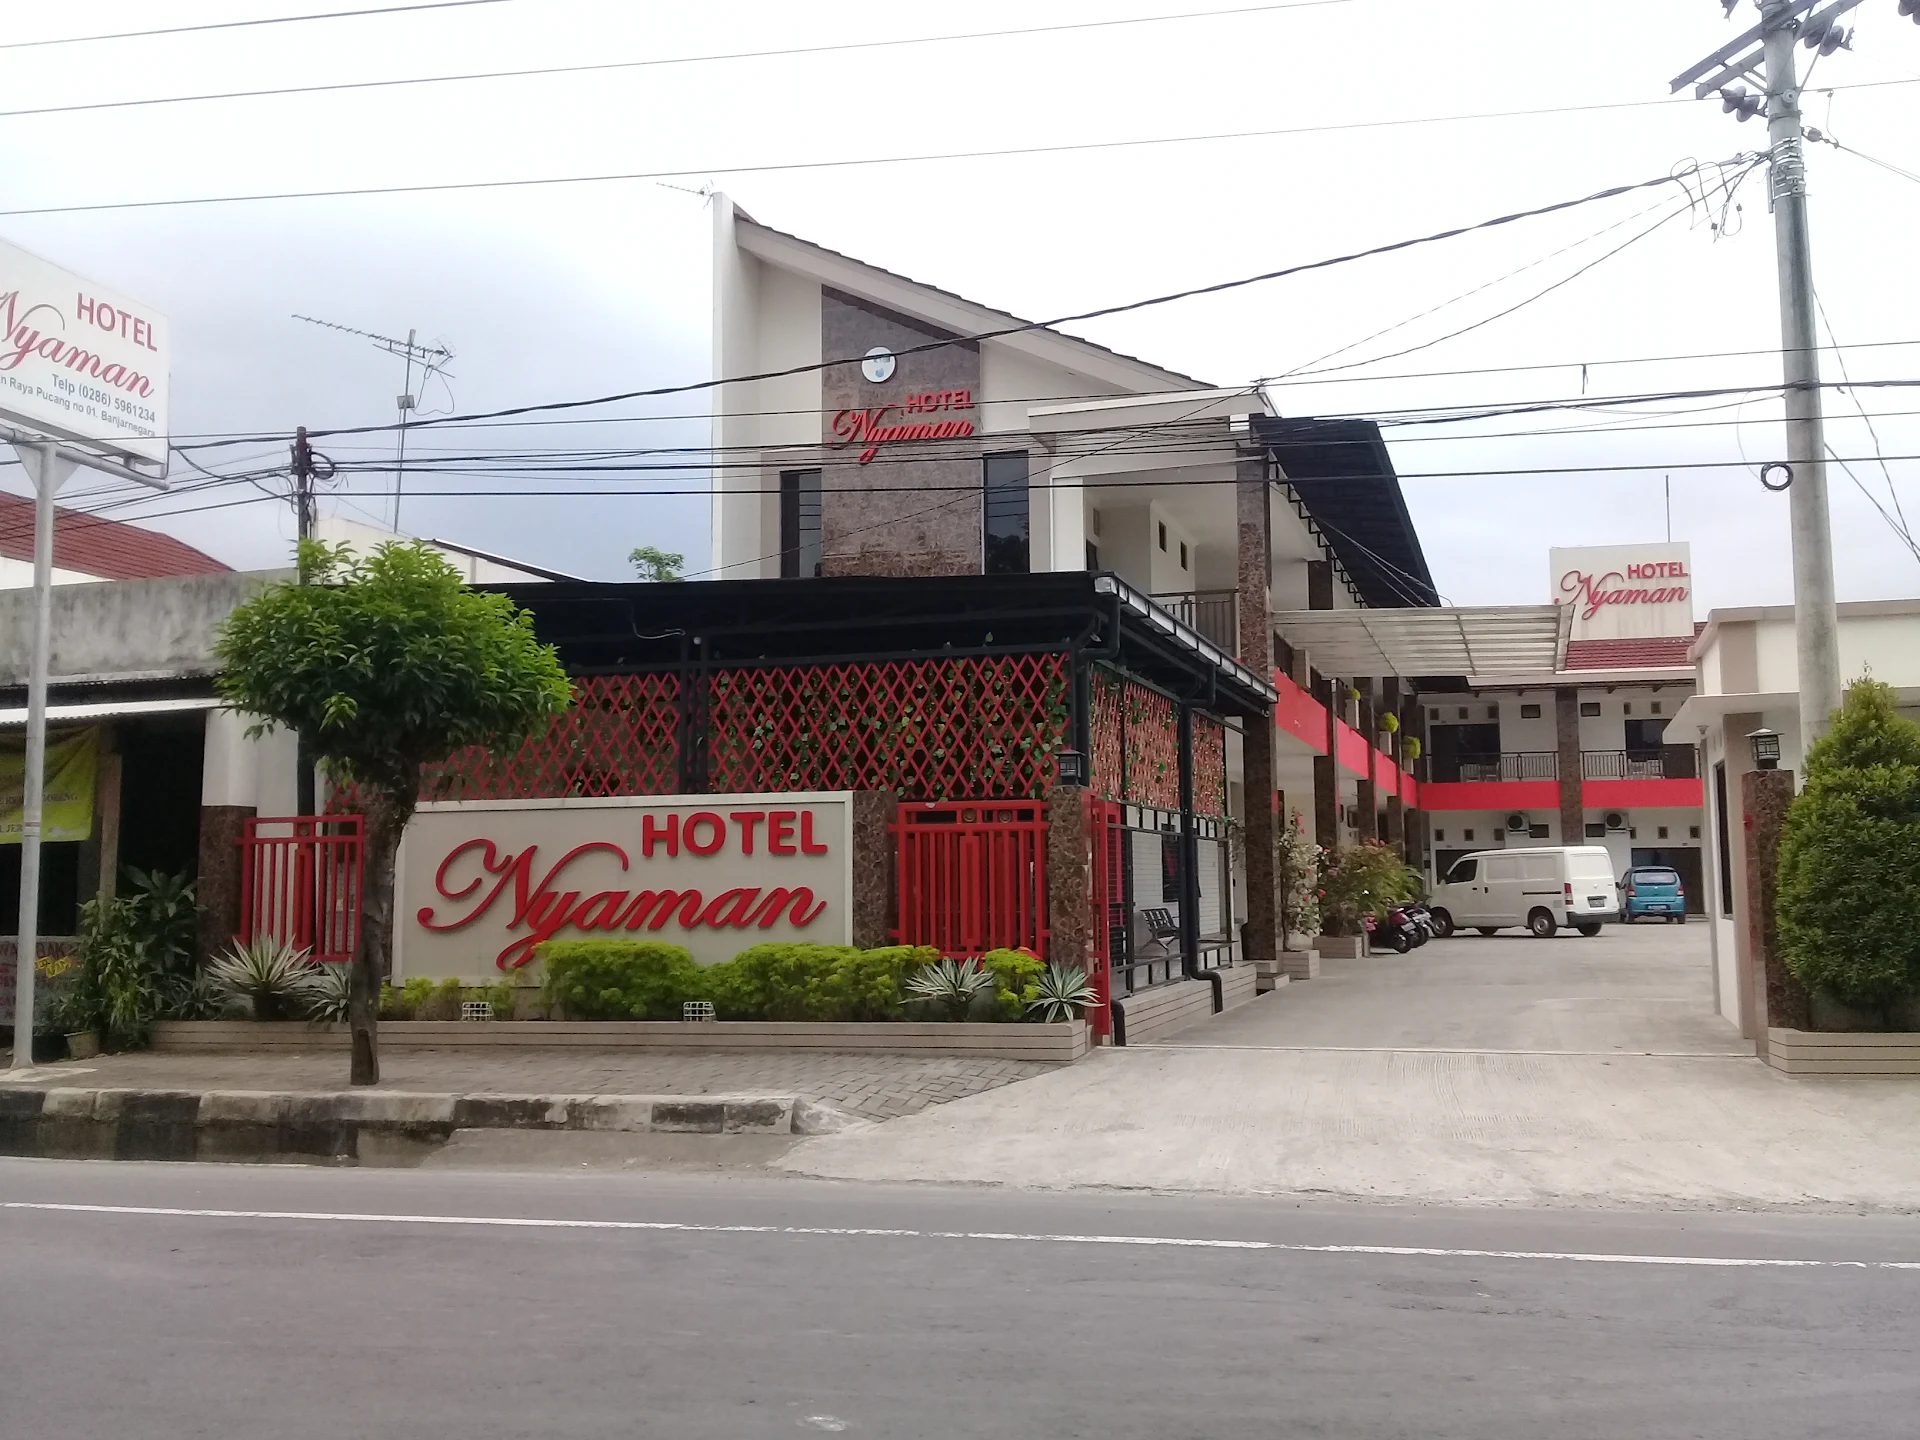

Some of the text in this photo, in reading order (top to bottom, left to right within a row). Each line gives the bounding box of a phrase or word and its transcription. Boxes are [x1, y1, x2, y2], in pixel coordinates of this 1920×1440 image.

[0, 290, 154, 398] Nyaman
[77, 292, 157, 352] HOTEL
[10, 377, 33, 395] Raya
[36, 387, 70, 411] Pucang
[73, 401, 84, 413] no
[101, 410, 155, 437] Banjarnegara
[52, 373, 155, 423] Telp (0286) 5961234
[905, 388, 975, 414] HOTEL
[827, 402, 975, 465] Nyaman
[1554, 570, 1689, 620] Nyaman
[1627, 561, 1689, 580] HOTEL
[642, 810, 828, 857] HOTEL
[416, 838, 827, 971] Nyaman
